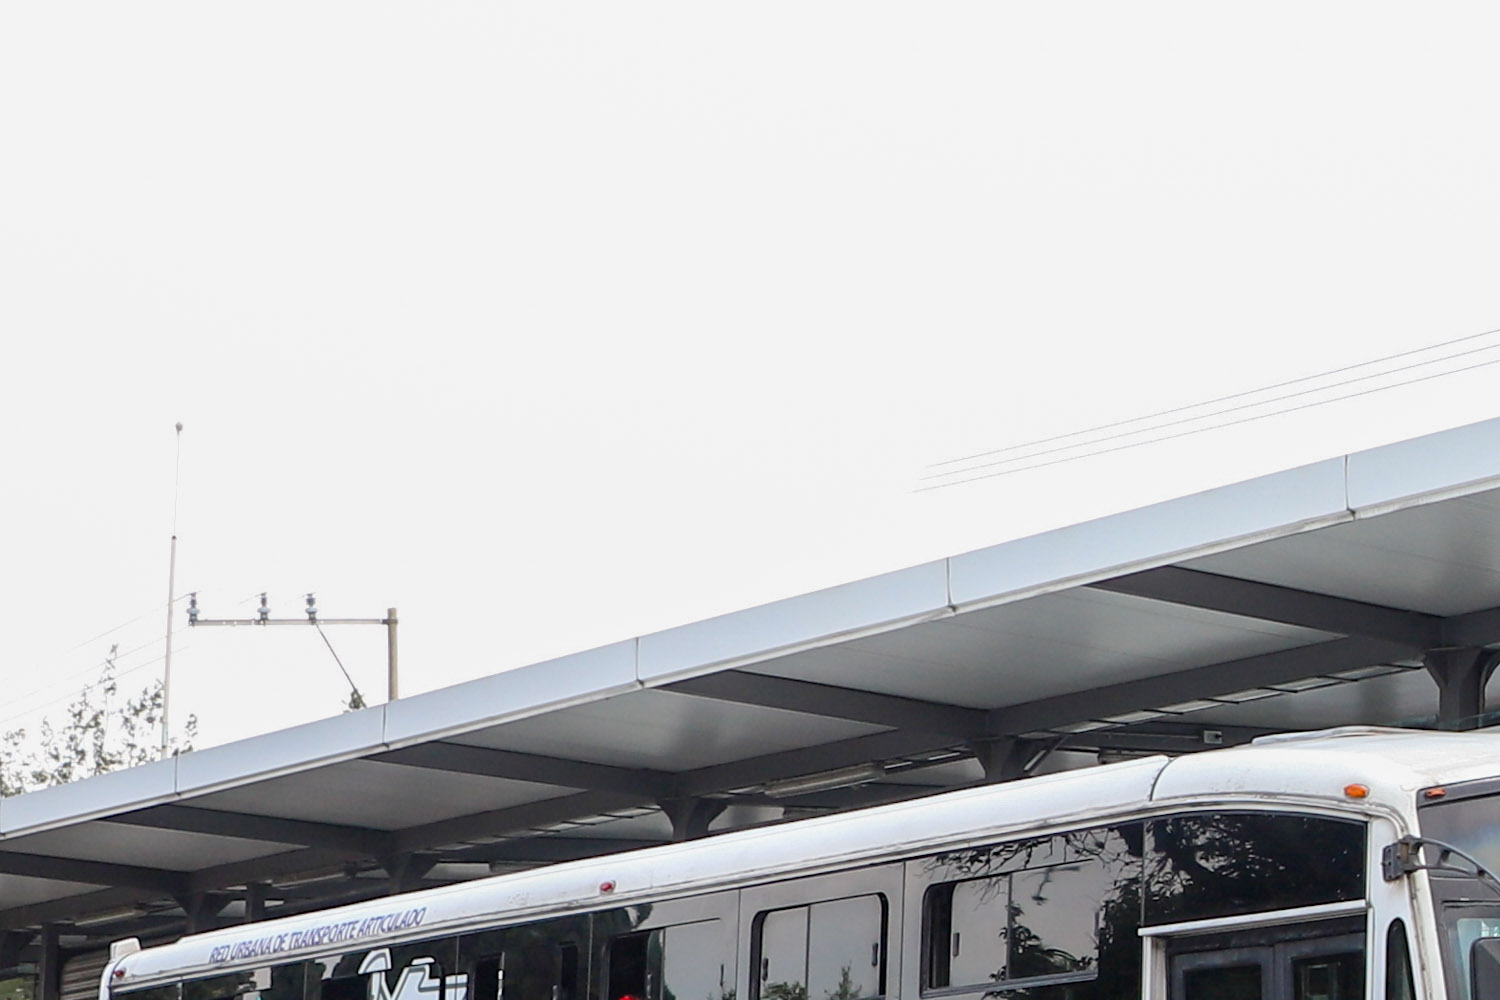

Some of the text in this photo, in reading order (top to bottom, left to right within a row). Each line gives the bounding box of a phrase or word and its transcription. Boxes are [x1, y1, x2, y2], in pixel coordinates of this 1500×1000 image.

[209, 907, 427, 963] RED URBANA DE TRANSPORTE ARTICULADO
